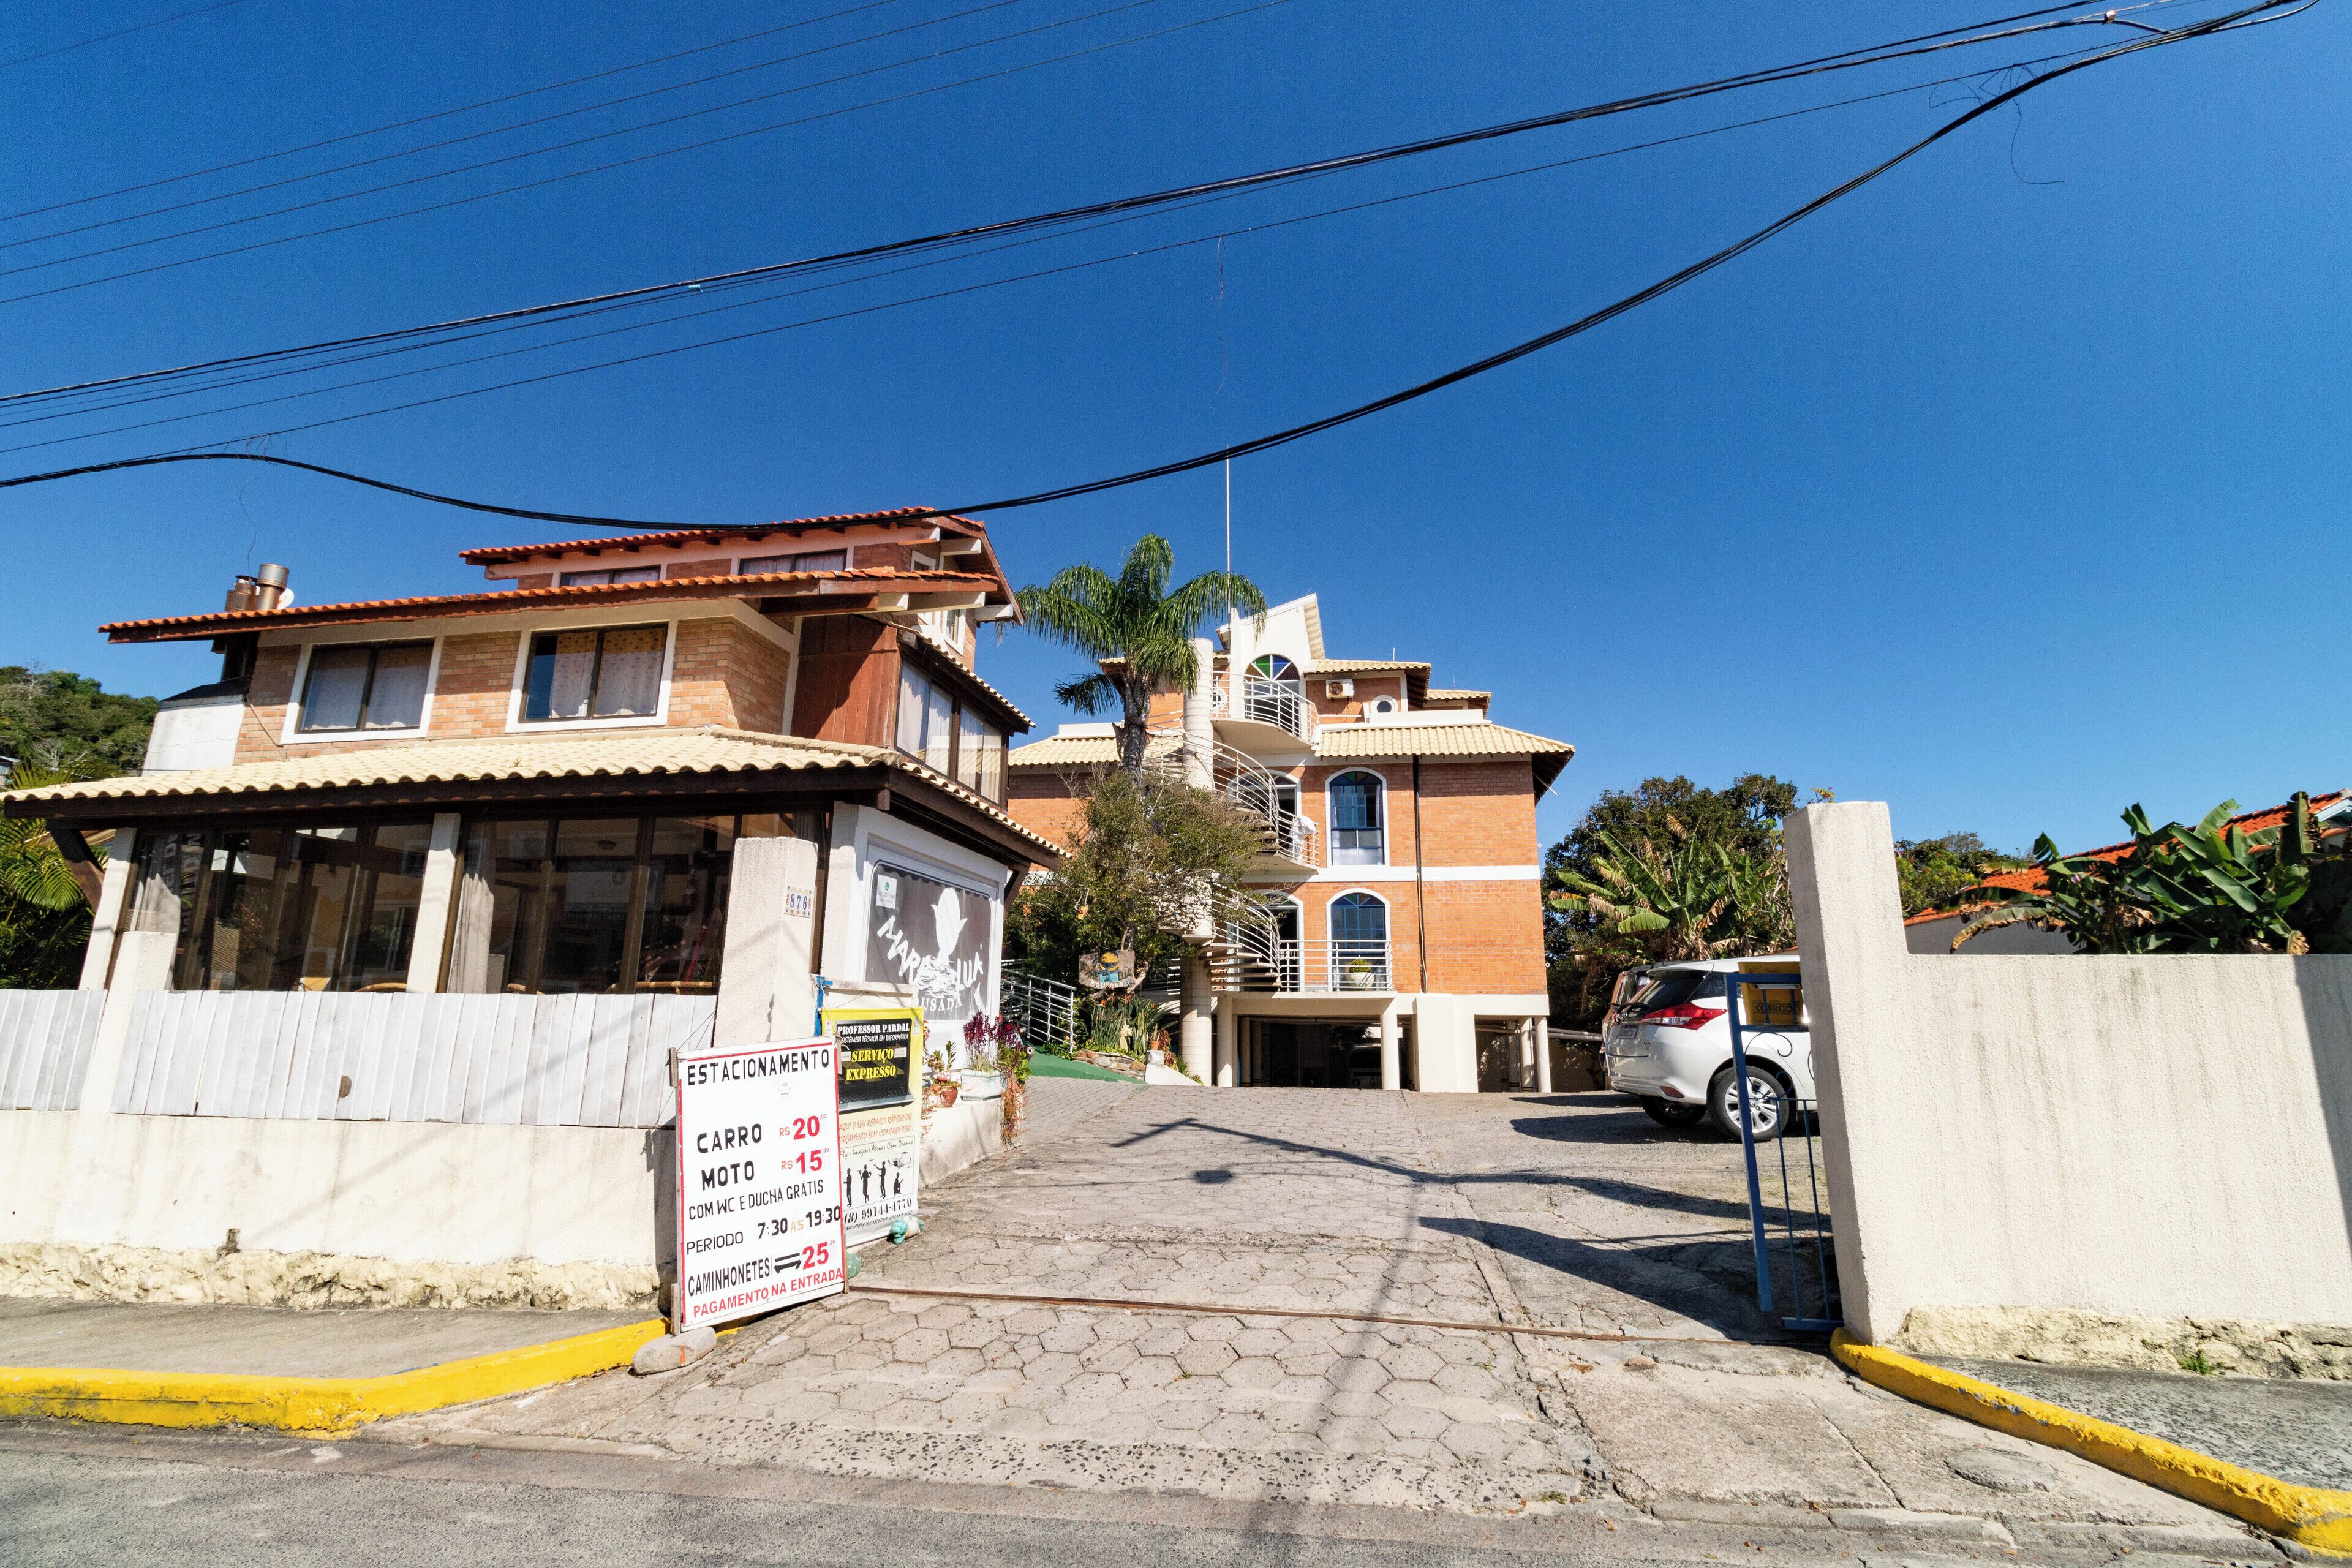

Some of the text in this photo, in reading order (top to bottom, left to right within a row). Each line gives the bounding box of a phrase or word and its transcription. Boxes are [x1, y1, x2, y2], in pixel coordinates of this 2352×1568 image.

[790, 894, 807, 910] 876
[921, 998, 963, 1011] USADA
[837, 1024, 881, 1035] PROFESSOR
[883, 1023, 910, 1033] PARDAL
[841, 1035, 861, 1044] SISTÊNCIA
[688, 1049, 829, 1086] ESTACIONAMENTO
[851, 1048, 894, 1064] SERVIÇO
[846, 1065, 897, 1081] EXPRESSO
[697, 1123, 762, 1153] CARRO
[701, 1161, 754, 1191] MOTO
[689, 1179, 824, 1220] COM WC E DUCHA GRÁTIS
[861, 1197, 912, 1219] 99144-4770
[687, 1232, 744, 1254] PERÍODO
[757, 1218, 788, 1239] 7:30
[805, 1205, 840, 1227] 19:30
[688, 1257, 770, 1297] CAMINHONETES
[693, 1268, 842, 1318] PAGAMENTO NA ENTRADA
